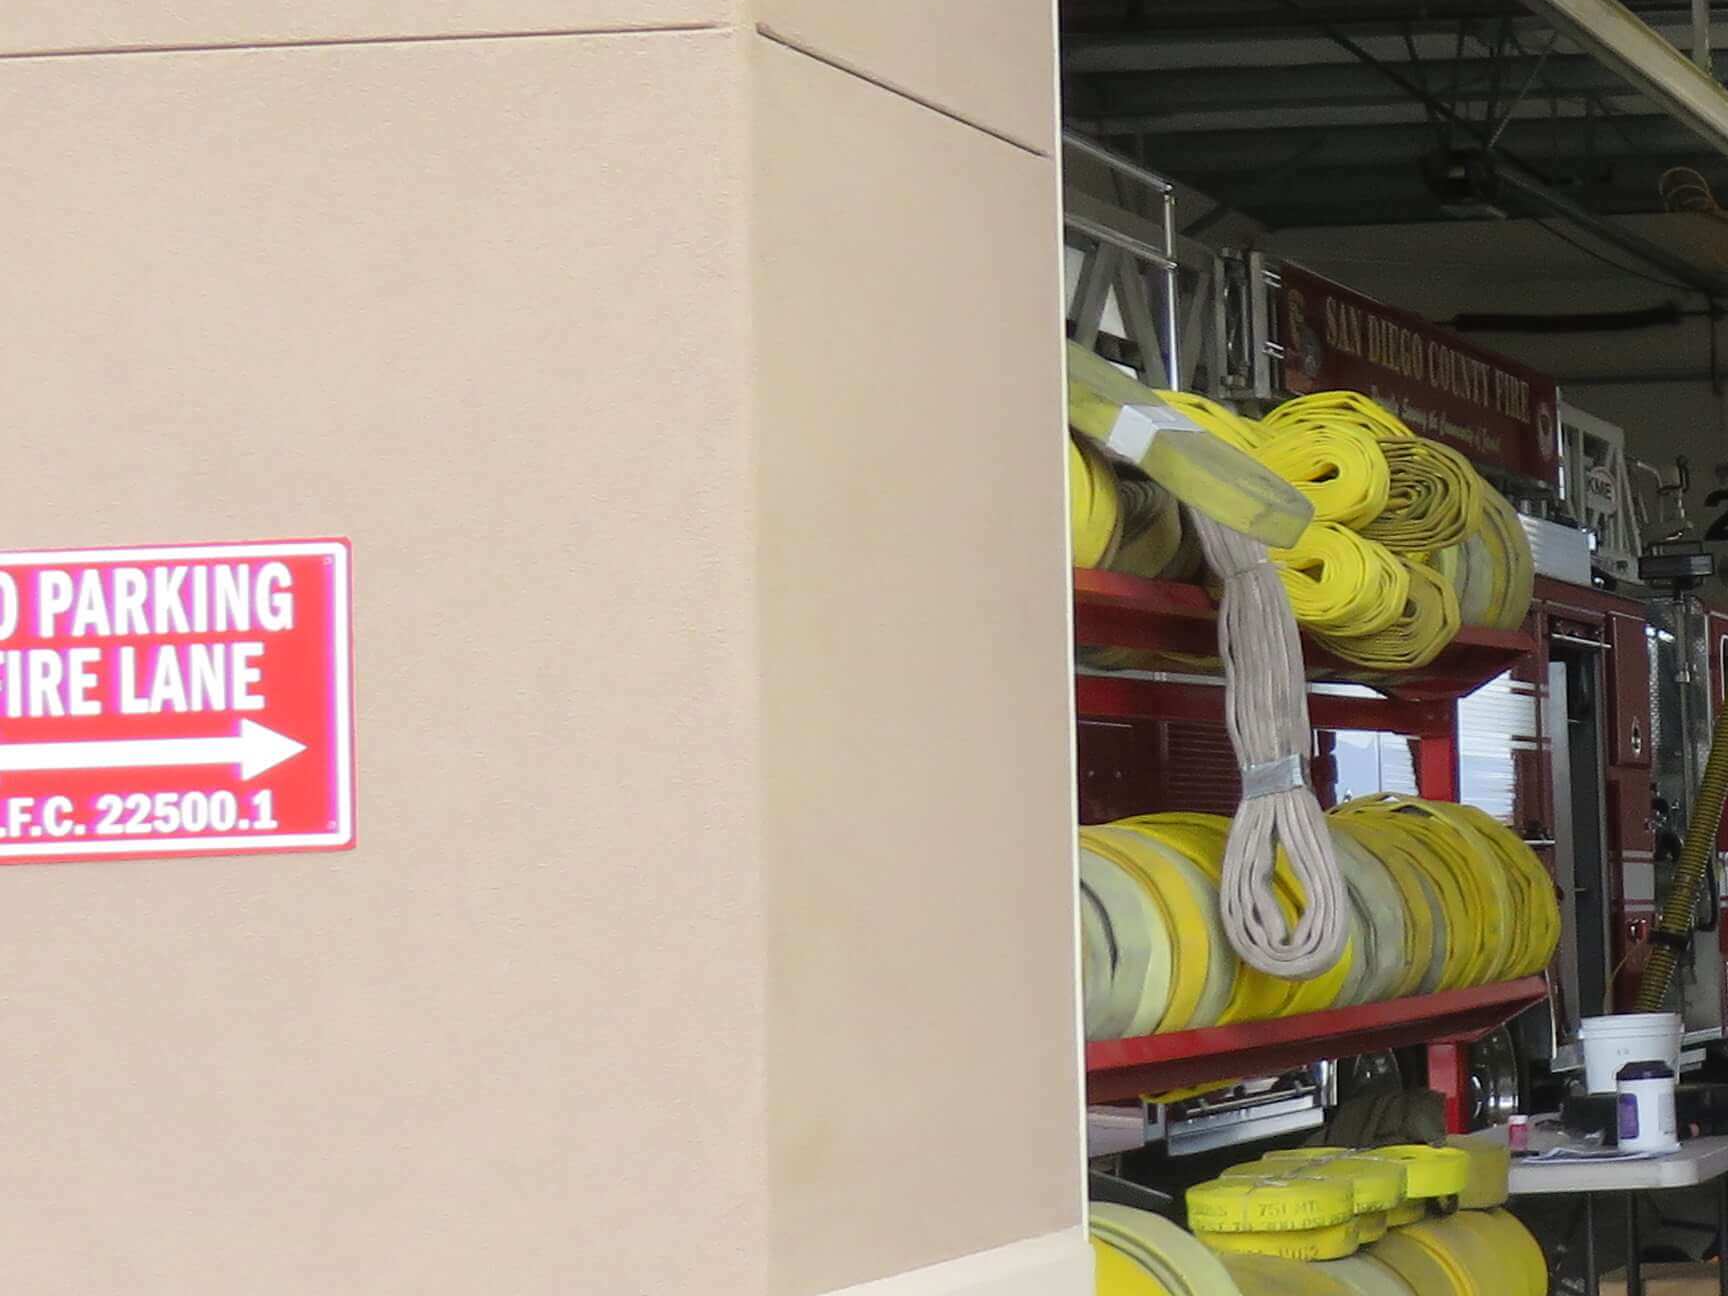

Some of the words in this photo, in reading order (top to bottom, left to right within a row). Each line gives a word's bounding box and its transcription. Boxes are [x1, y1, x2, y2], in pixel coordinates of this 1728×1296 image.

[1326, 295, 1362, 356] SAN
[1367, 314, 1423, 382] DIEGO
[1428, 340, 1491, 408] COUNTY
[1494, 368, 1531, 425] FIRE
[38, 562, 295, 638] PARKING
[0, 648, 102, 718] IRE
[118, 641, 266, 715] LANE
[96, 789, 279, 834] 22500.1
